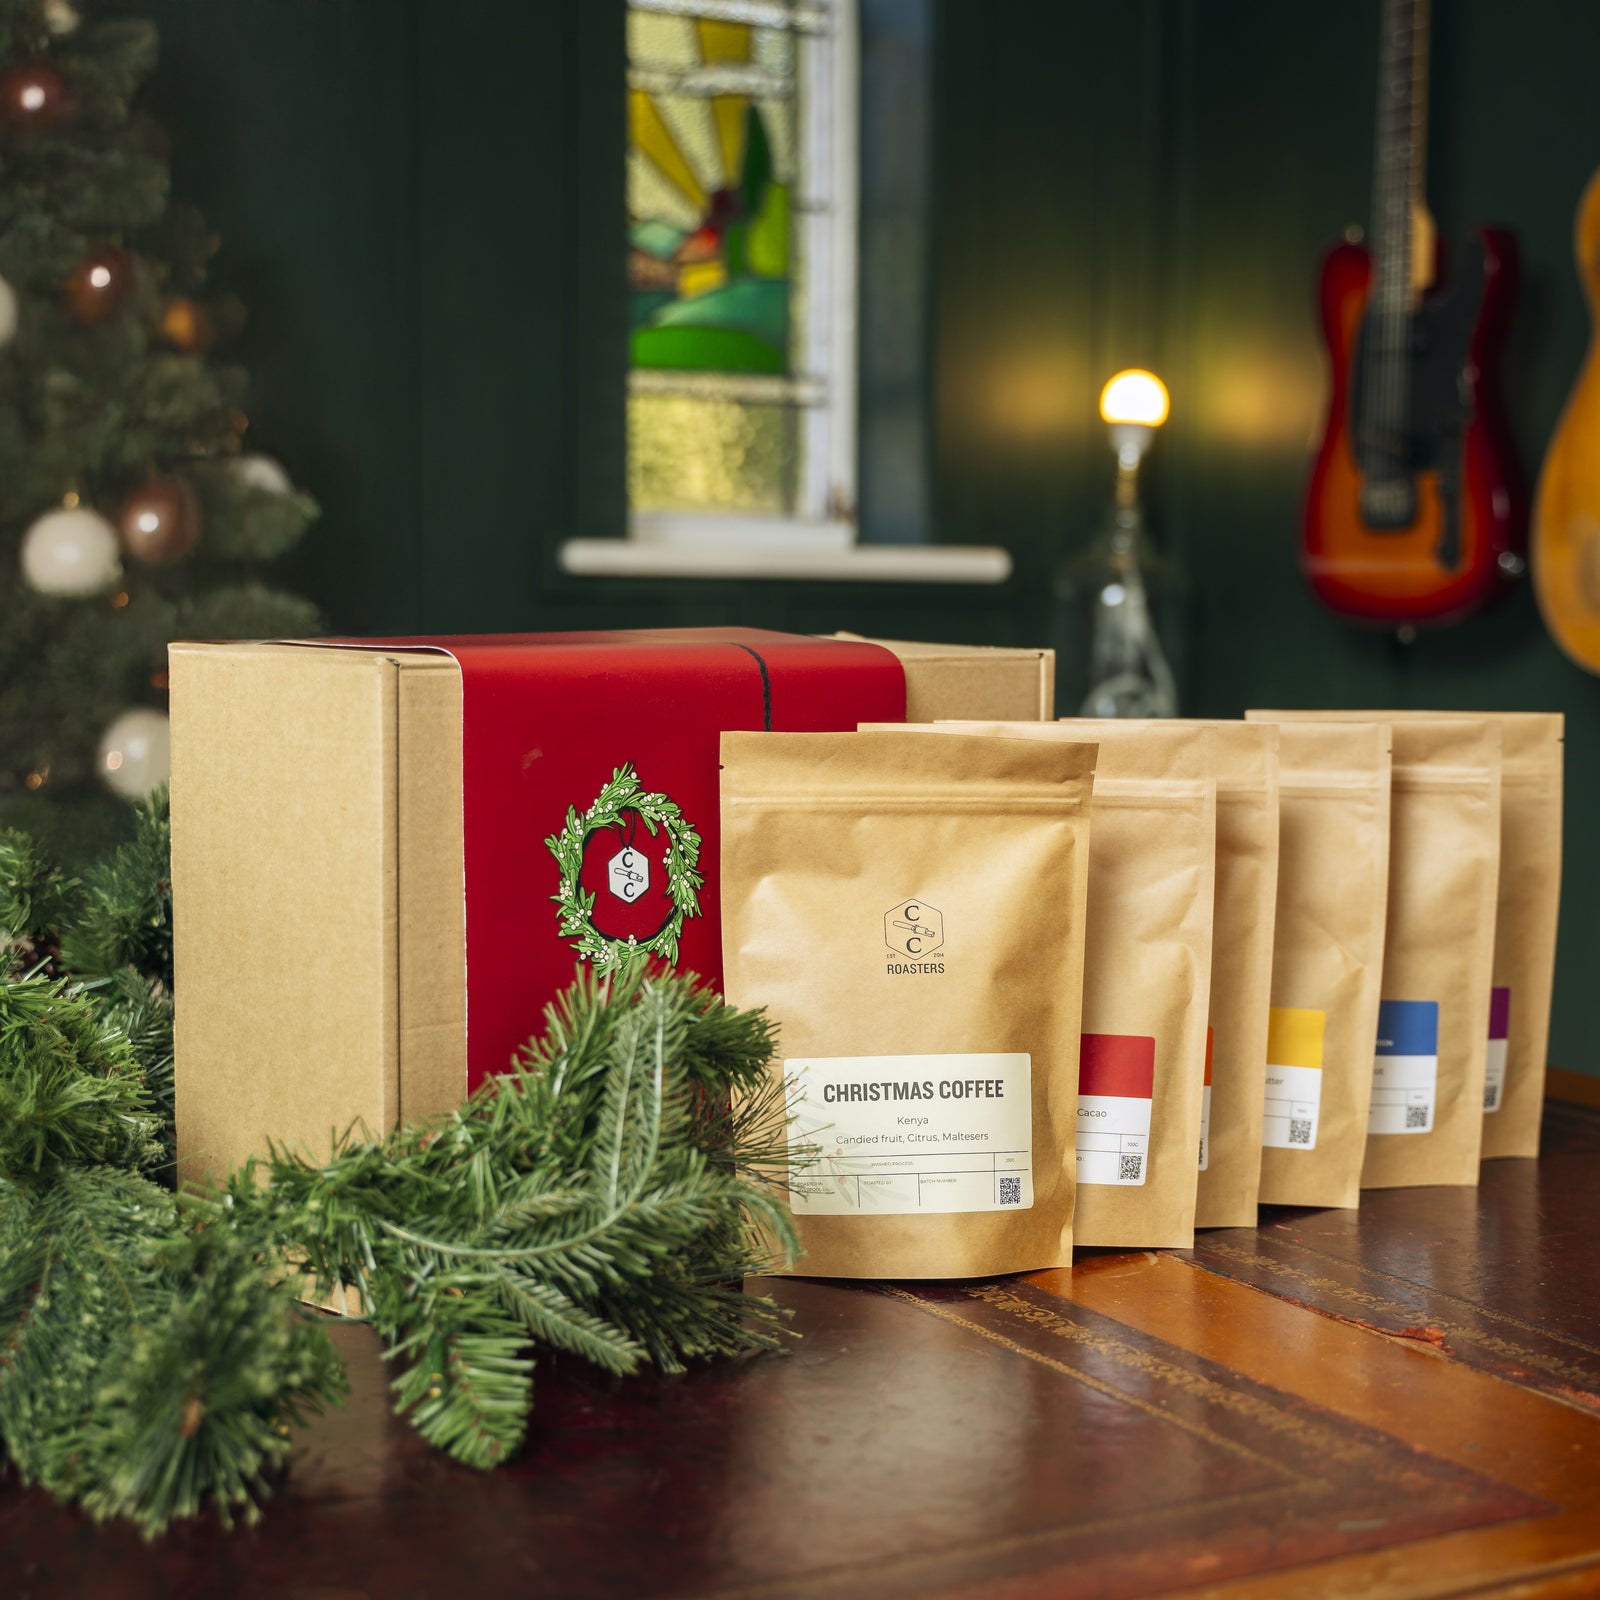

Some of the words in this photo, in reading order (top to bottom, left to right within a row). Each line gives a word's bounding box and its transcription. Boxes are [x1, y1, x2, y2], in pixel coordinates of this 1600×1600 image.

[622, 851, 633, 868] C
[623, 882, 635, 898] C
[904, 905, 920, 922] C
[906, 937, 922, 954] C
[887, 963, 945, 975] ROASTERS
[823, 1080, 934, 1103] CHRISTMAS
[939, 1079, 1004, 1100] COFFEE
[897, 1115, 929, 1126] Kenya
[1077, 1108, 1107, 1118] Cacao
[836, 1133, 879, 1145] Candied
[881, 1132, 905, 1144] fruit,
[907, 1132, 940, 1143] Citrus,
[942, 1131, 989, 1142] Maltesers
